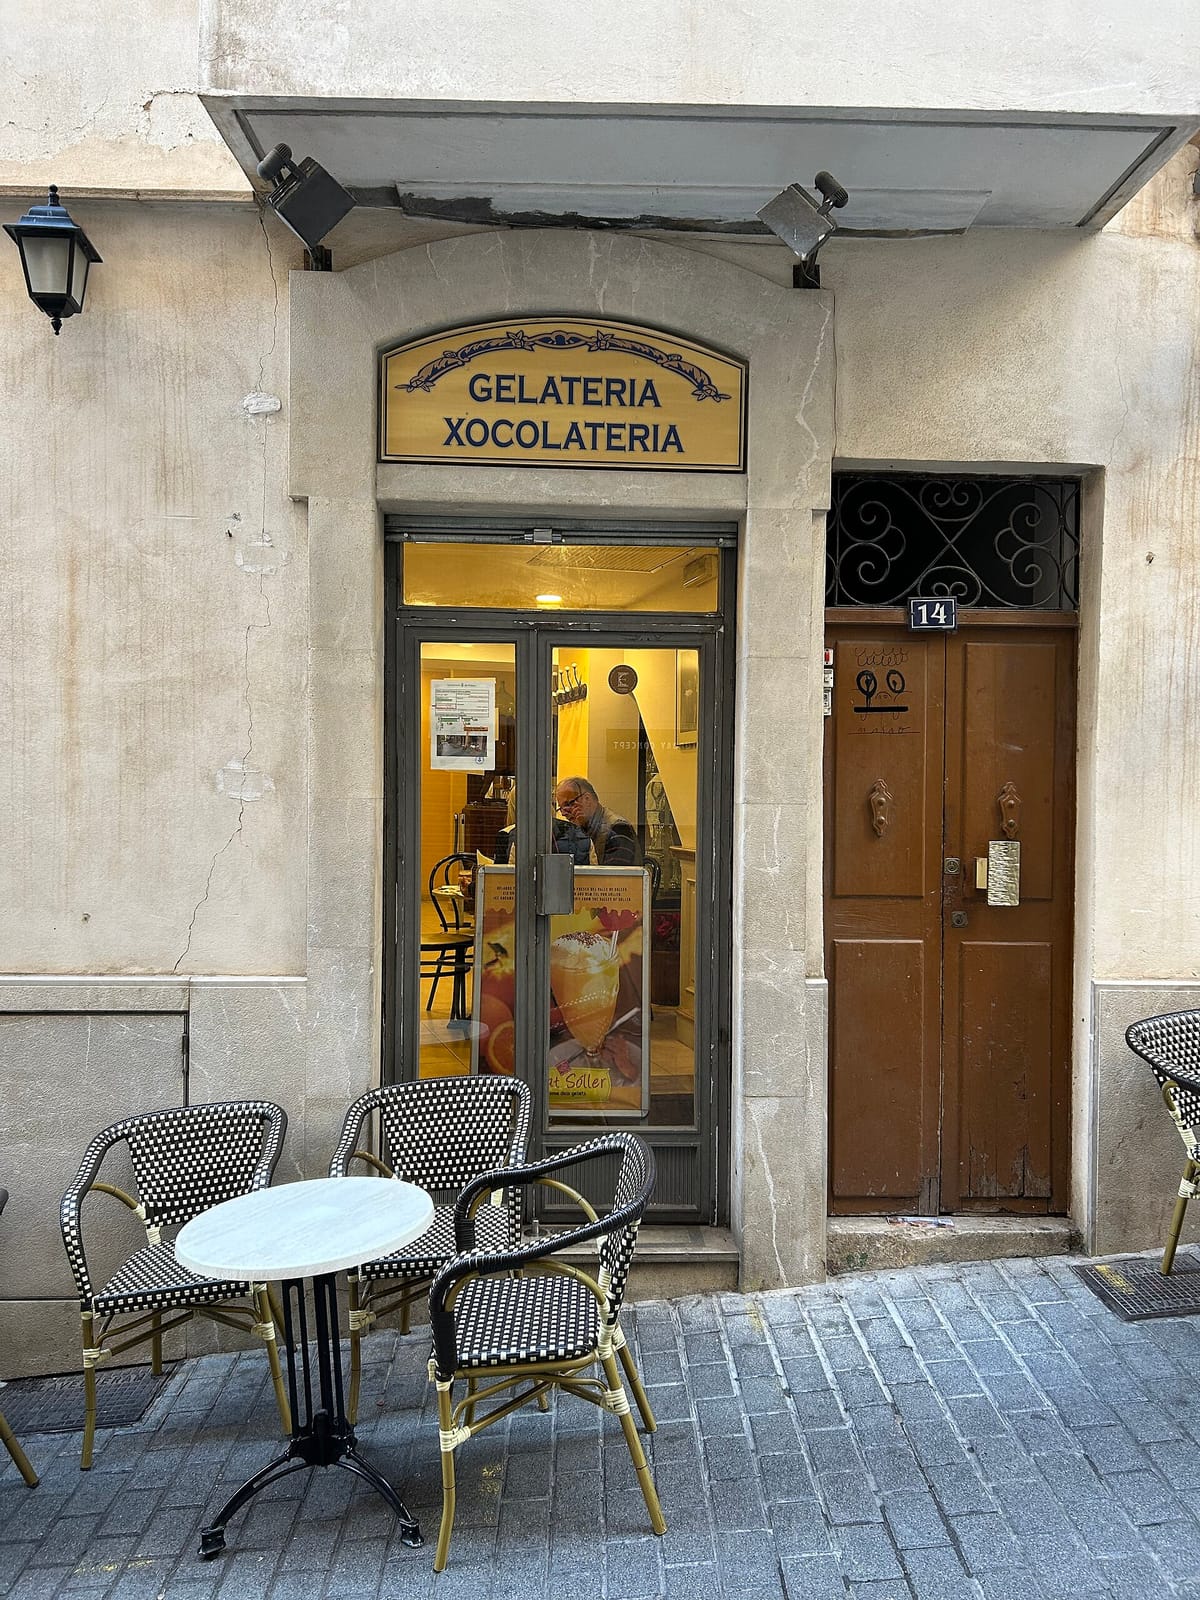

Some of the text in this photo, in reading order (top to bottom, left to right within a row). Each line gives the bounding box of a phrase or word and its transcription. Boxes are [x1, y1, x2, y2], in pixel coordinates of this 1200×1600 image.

[469, 373, 662, 408] GELATERIA
[442, 417, 686, 453] XOCOLATERIA
[917, 602, 947, 625] 14
[565, 1072, 607, 1089] Sóller
